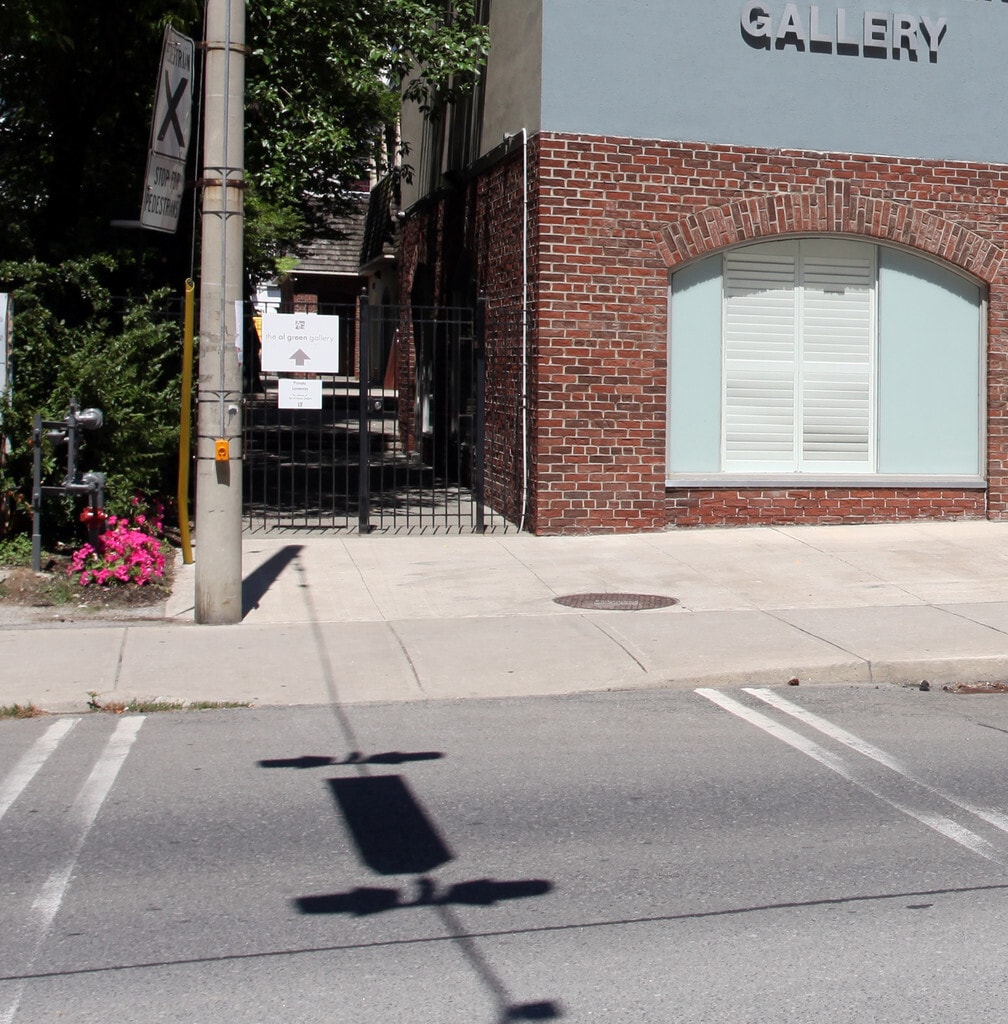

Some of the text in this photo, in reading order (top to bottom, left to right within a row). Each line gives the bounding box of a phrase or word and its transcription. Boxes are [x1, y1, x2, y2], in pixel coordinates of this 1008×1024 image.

[741, 0, 947, 57] GALLERY
[154, 166, 181, 190] STOP FOR
[310, 334, 334, 342] gallery
